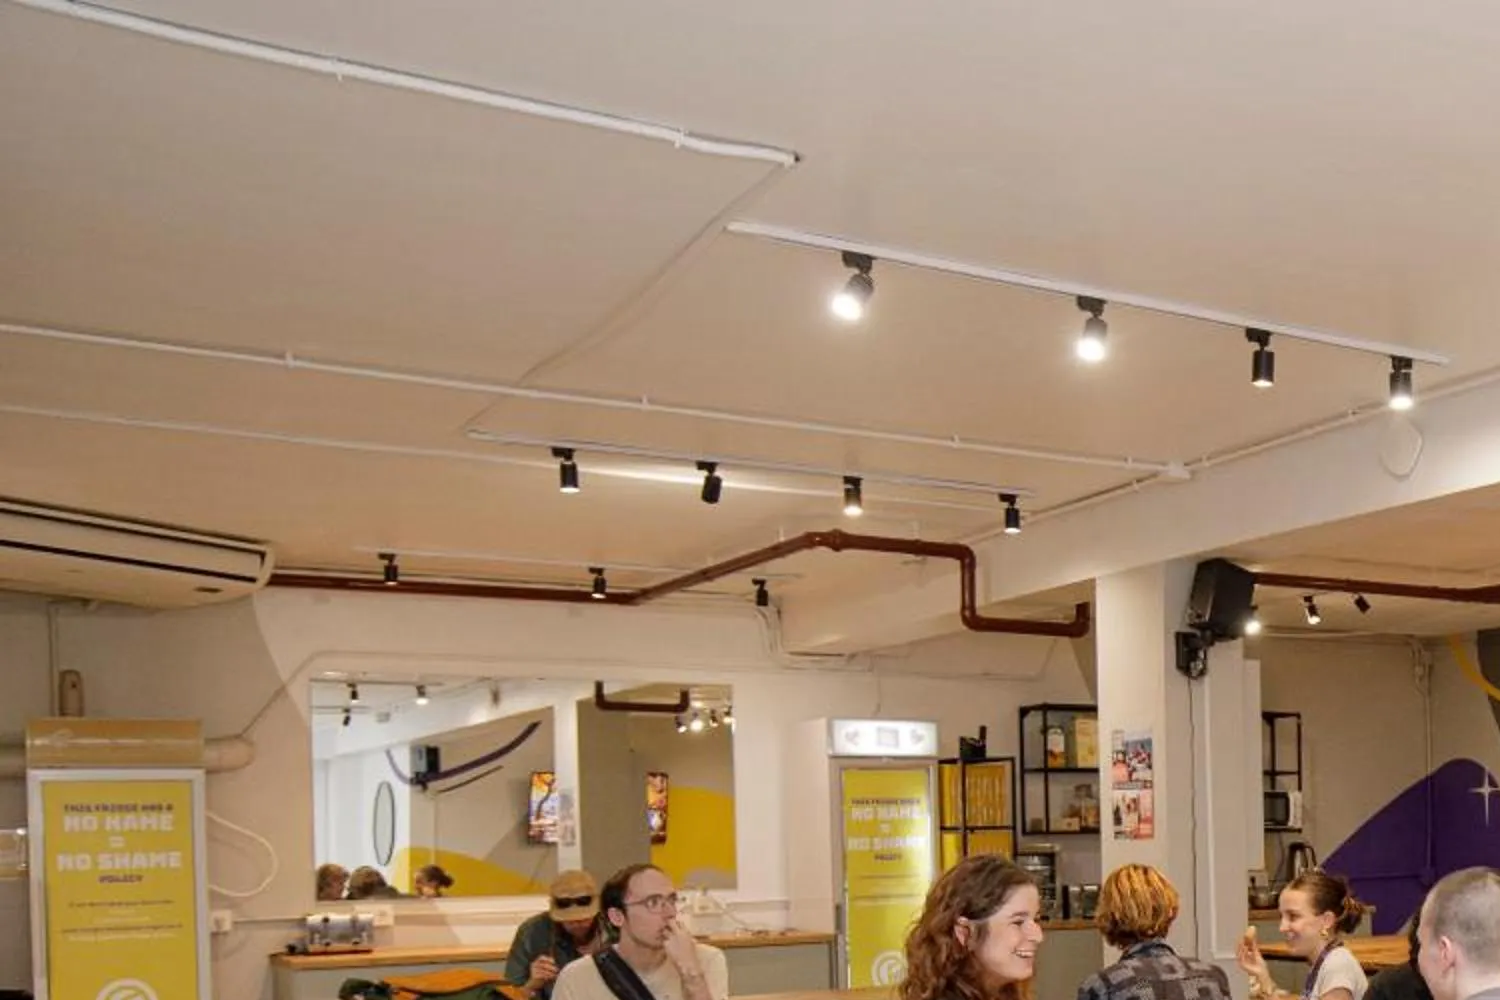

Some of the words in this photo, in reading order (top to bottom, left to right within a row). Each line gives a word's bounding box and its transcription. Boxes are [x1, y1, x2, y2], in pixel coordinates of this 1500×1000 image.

[64, 816, 98, 833] NO
[104, 814, 174, 831] NAME
[57, 853, 91, 871] NO
[98, 851, 182, 869] SHAME
